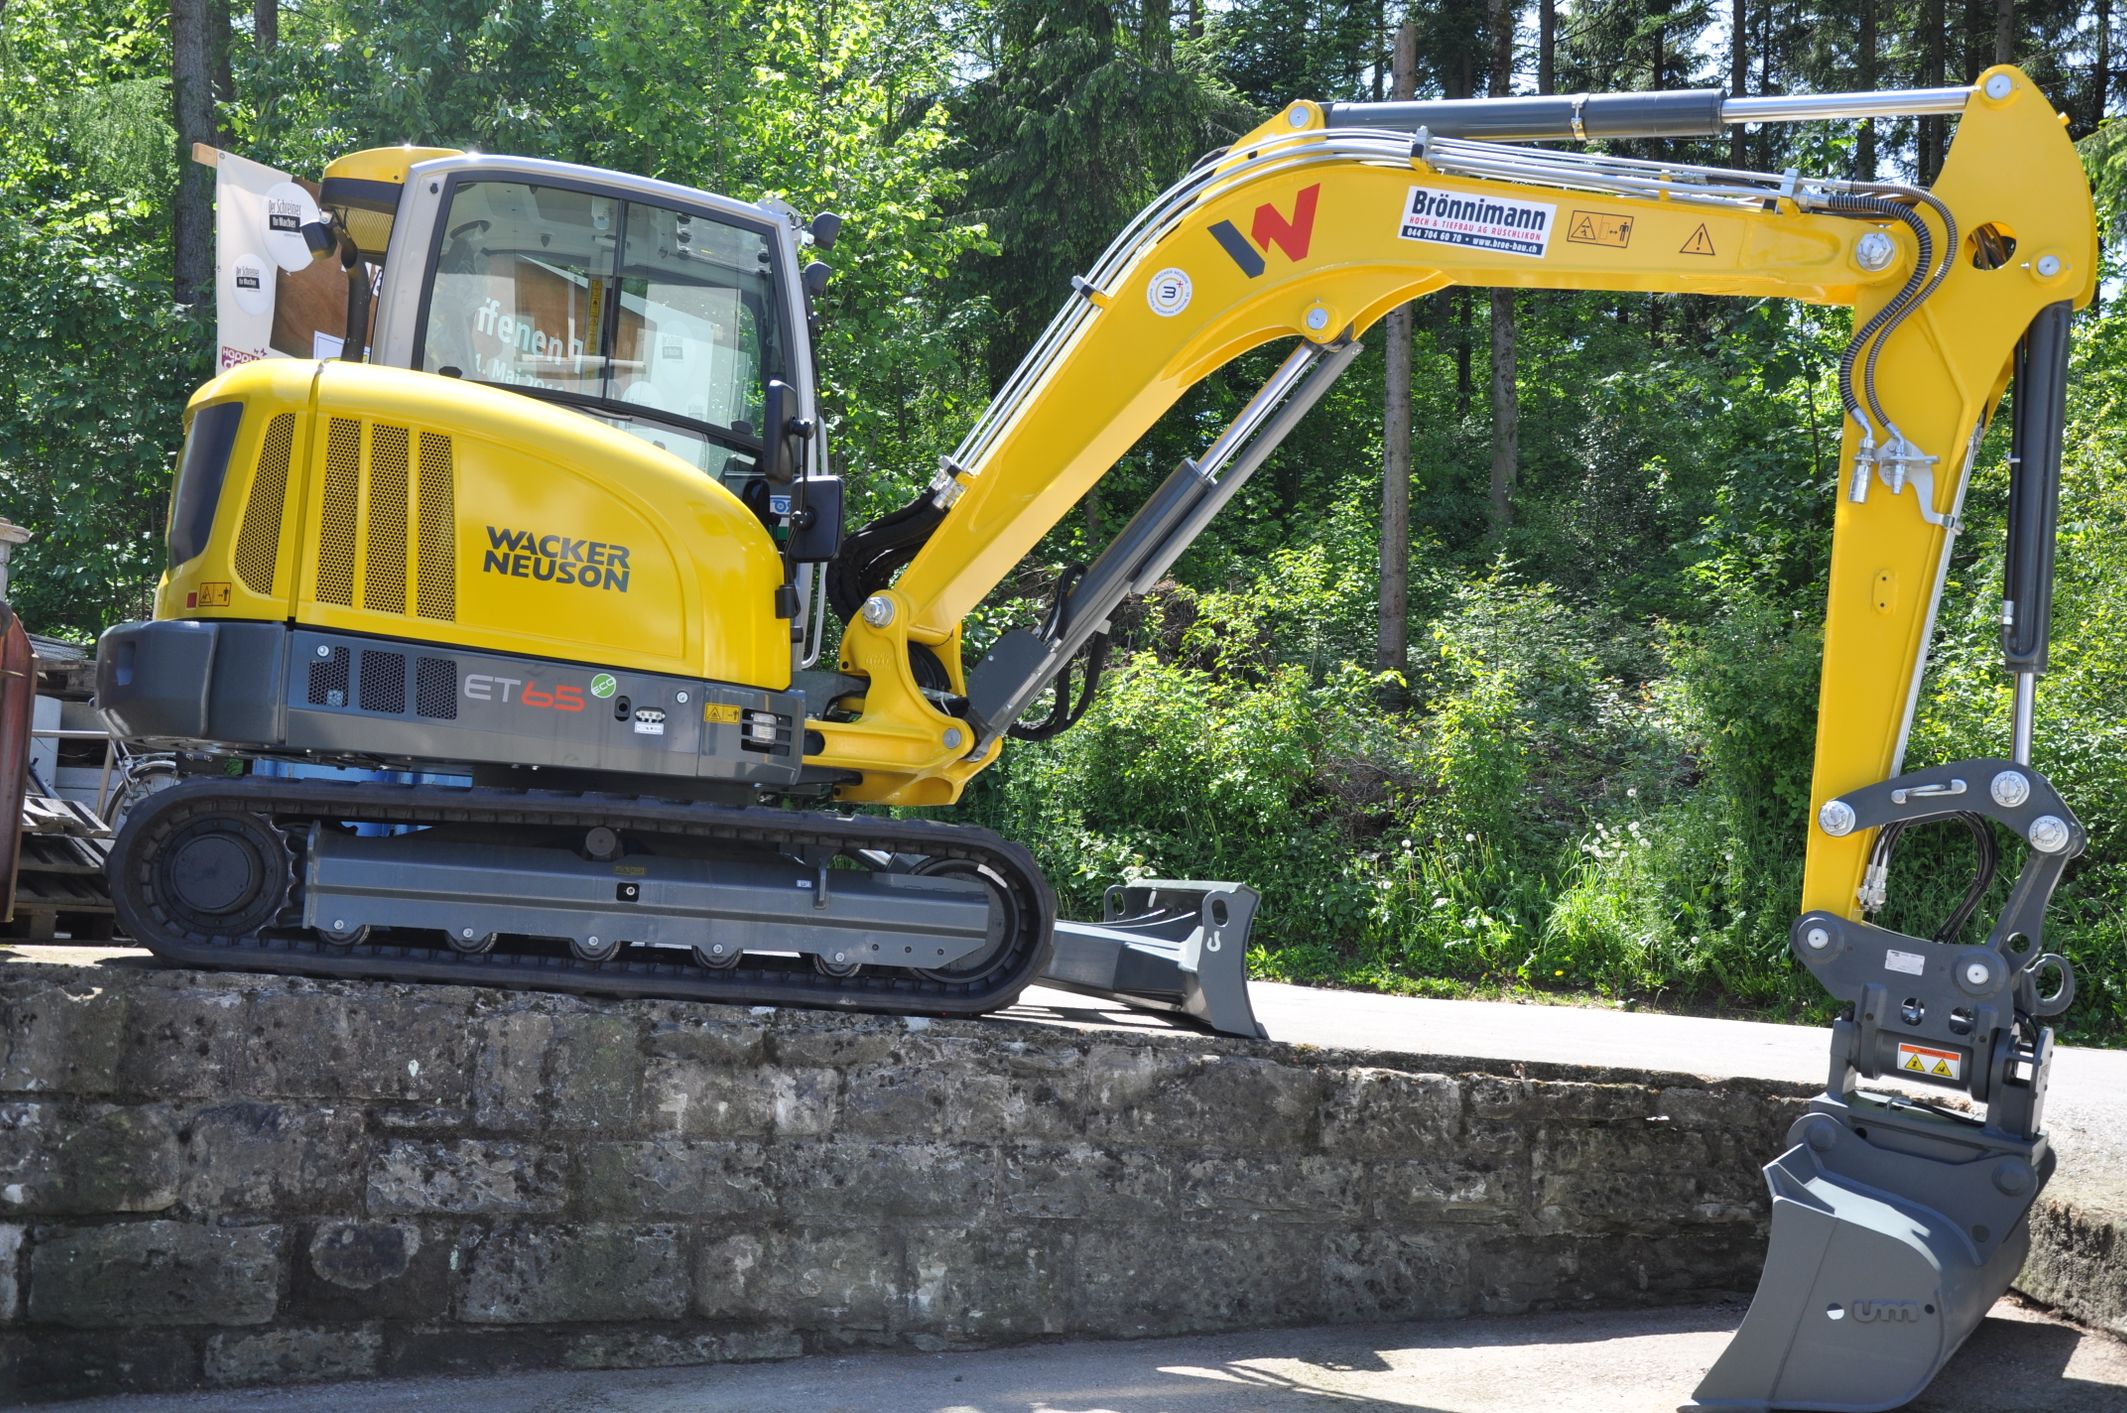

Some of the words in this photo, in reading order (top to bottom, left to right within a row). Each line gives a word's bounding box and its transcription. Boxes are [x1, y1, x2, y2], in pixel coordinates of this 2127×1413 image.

[1409, 216, 1430, 226] HOCH
[1432, 219, 1438, 227] &
[1442, 220, 1474, 232] TIEFBAU
[1477, 225, 1488, 234] AG
[1491, 227, 1541, 241] RÜSCHLIKON
[1411, 190, 1546, 231] Brönnimann
[1406, 227, 1422, 237] 044
[1424, 229, 1438, 239] 704
[1440, 232, 1450, 241] 60
[1452, 233, 1462, 242] 70
[1472, 237, 1538, 253] www.broe-bau.ch
[486, 525, 631, 570] WACKER
[483, 550, 630, 593] NEUSON
[464, 673, 587, 712] ET65
[591, 677, 616, 696] ECO
